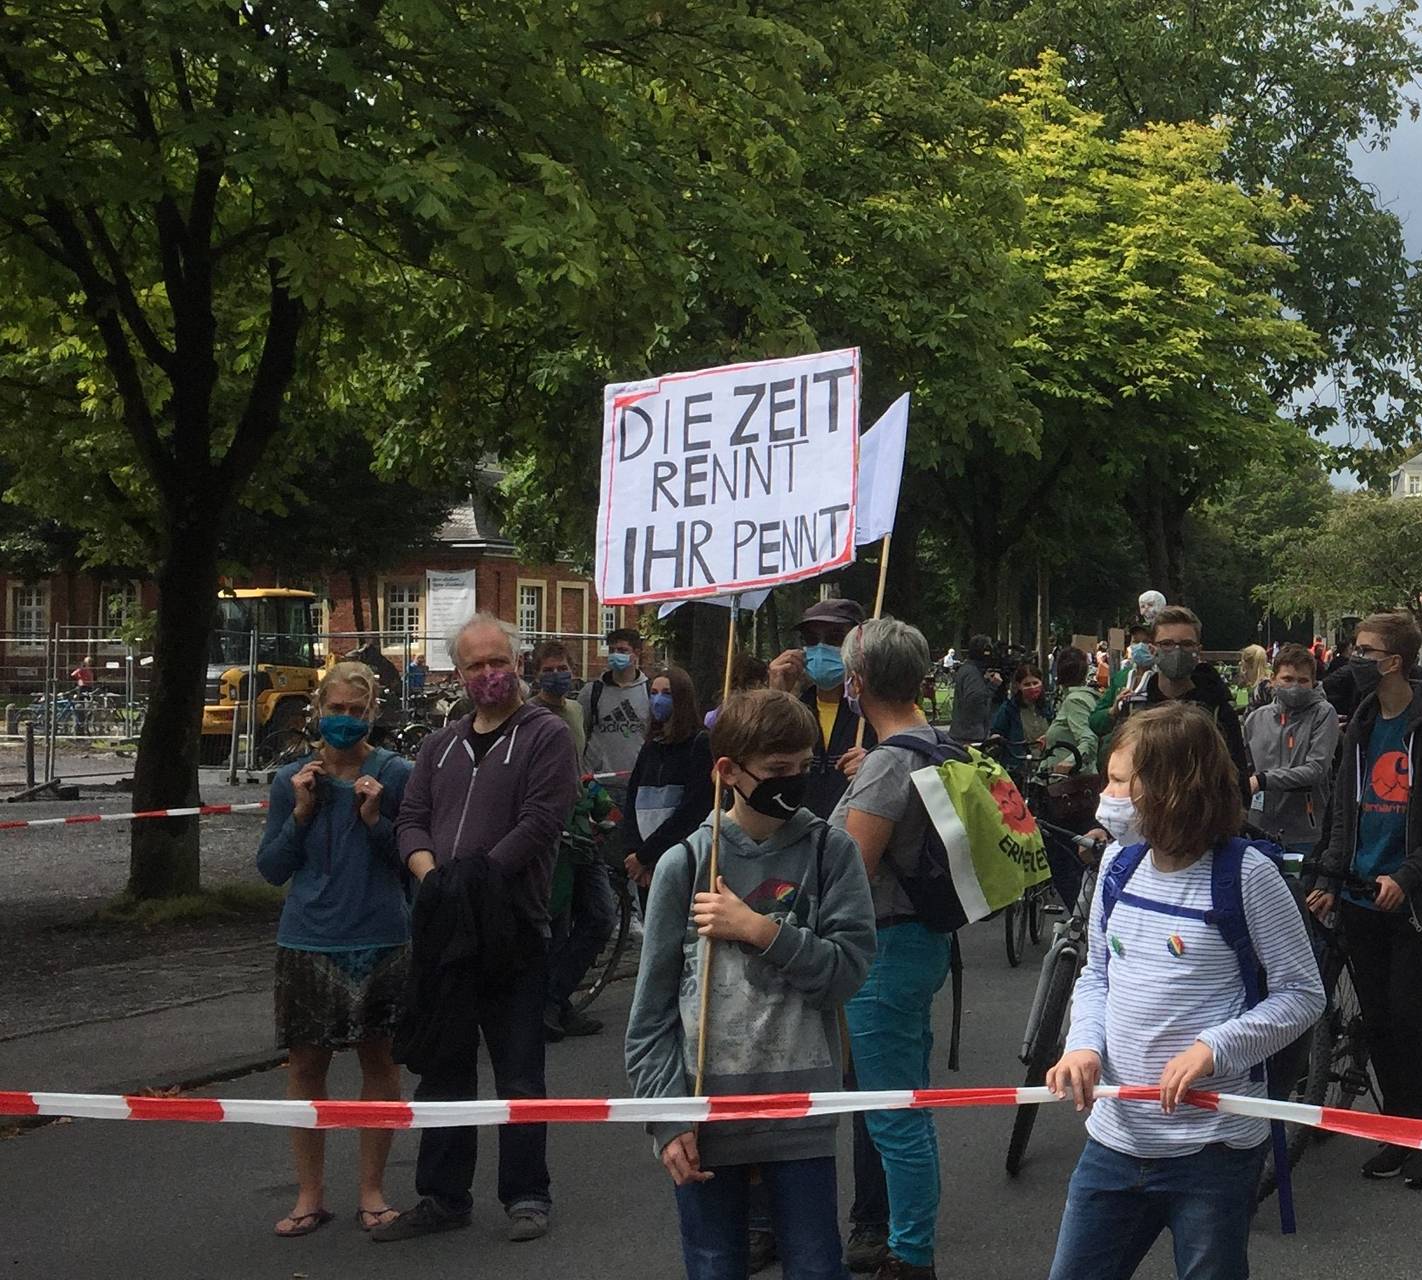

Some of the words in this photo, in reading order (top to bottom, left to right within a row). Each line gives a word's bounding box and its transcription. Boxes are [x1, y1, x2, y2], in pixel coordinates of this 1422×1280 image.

[619, 392, 713, 462] DIE
[730, 366, 854, 446] ZEIT
[651, 440, 809, 512] RENNT
[623, 520, 716, 594] IHR
[733, 503, 850, 580] PENNT
